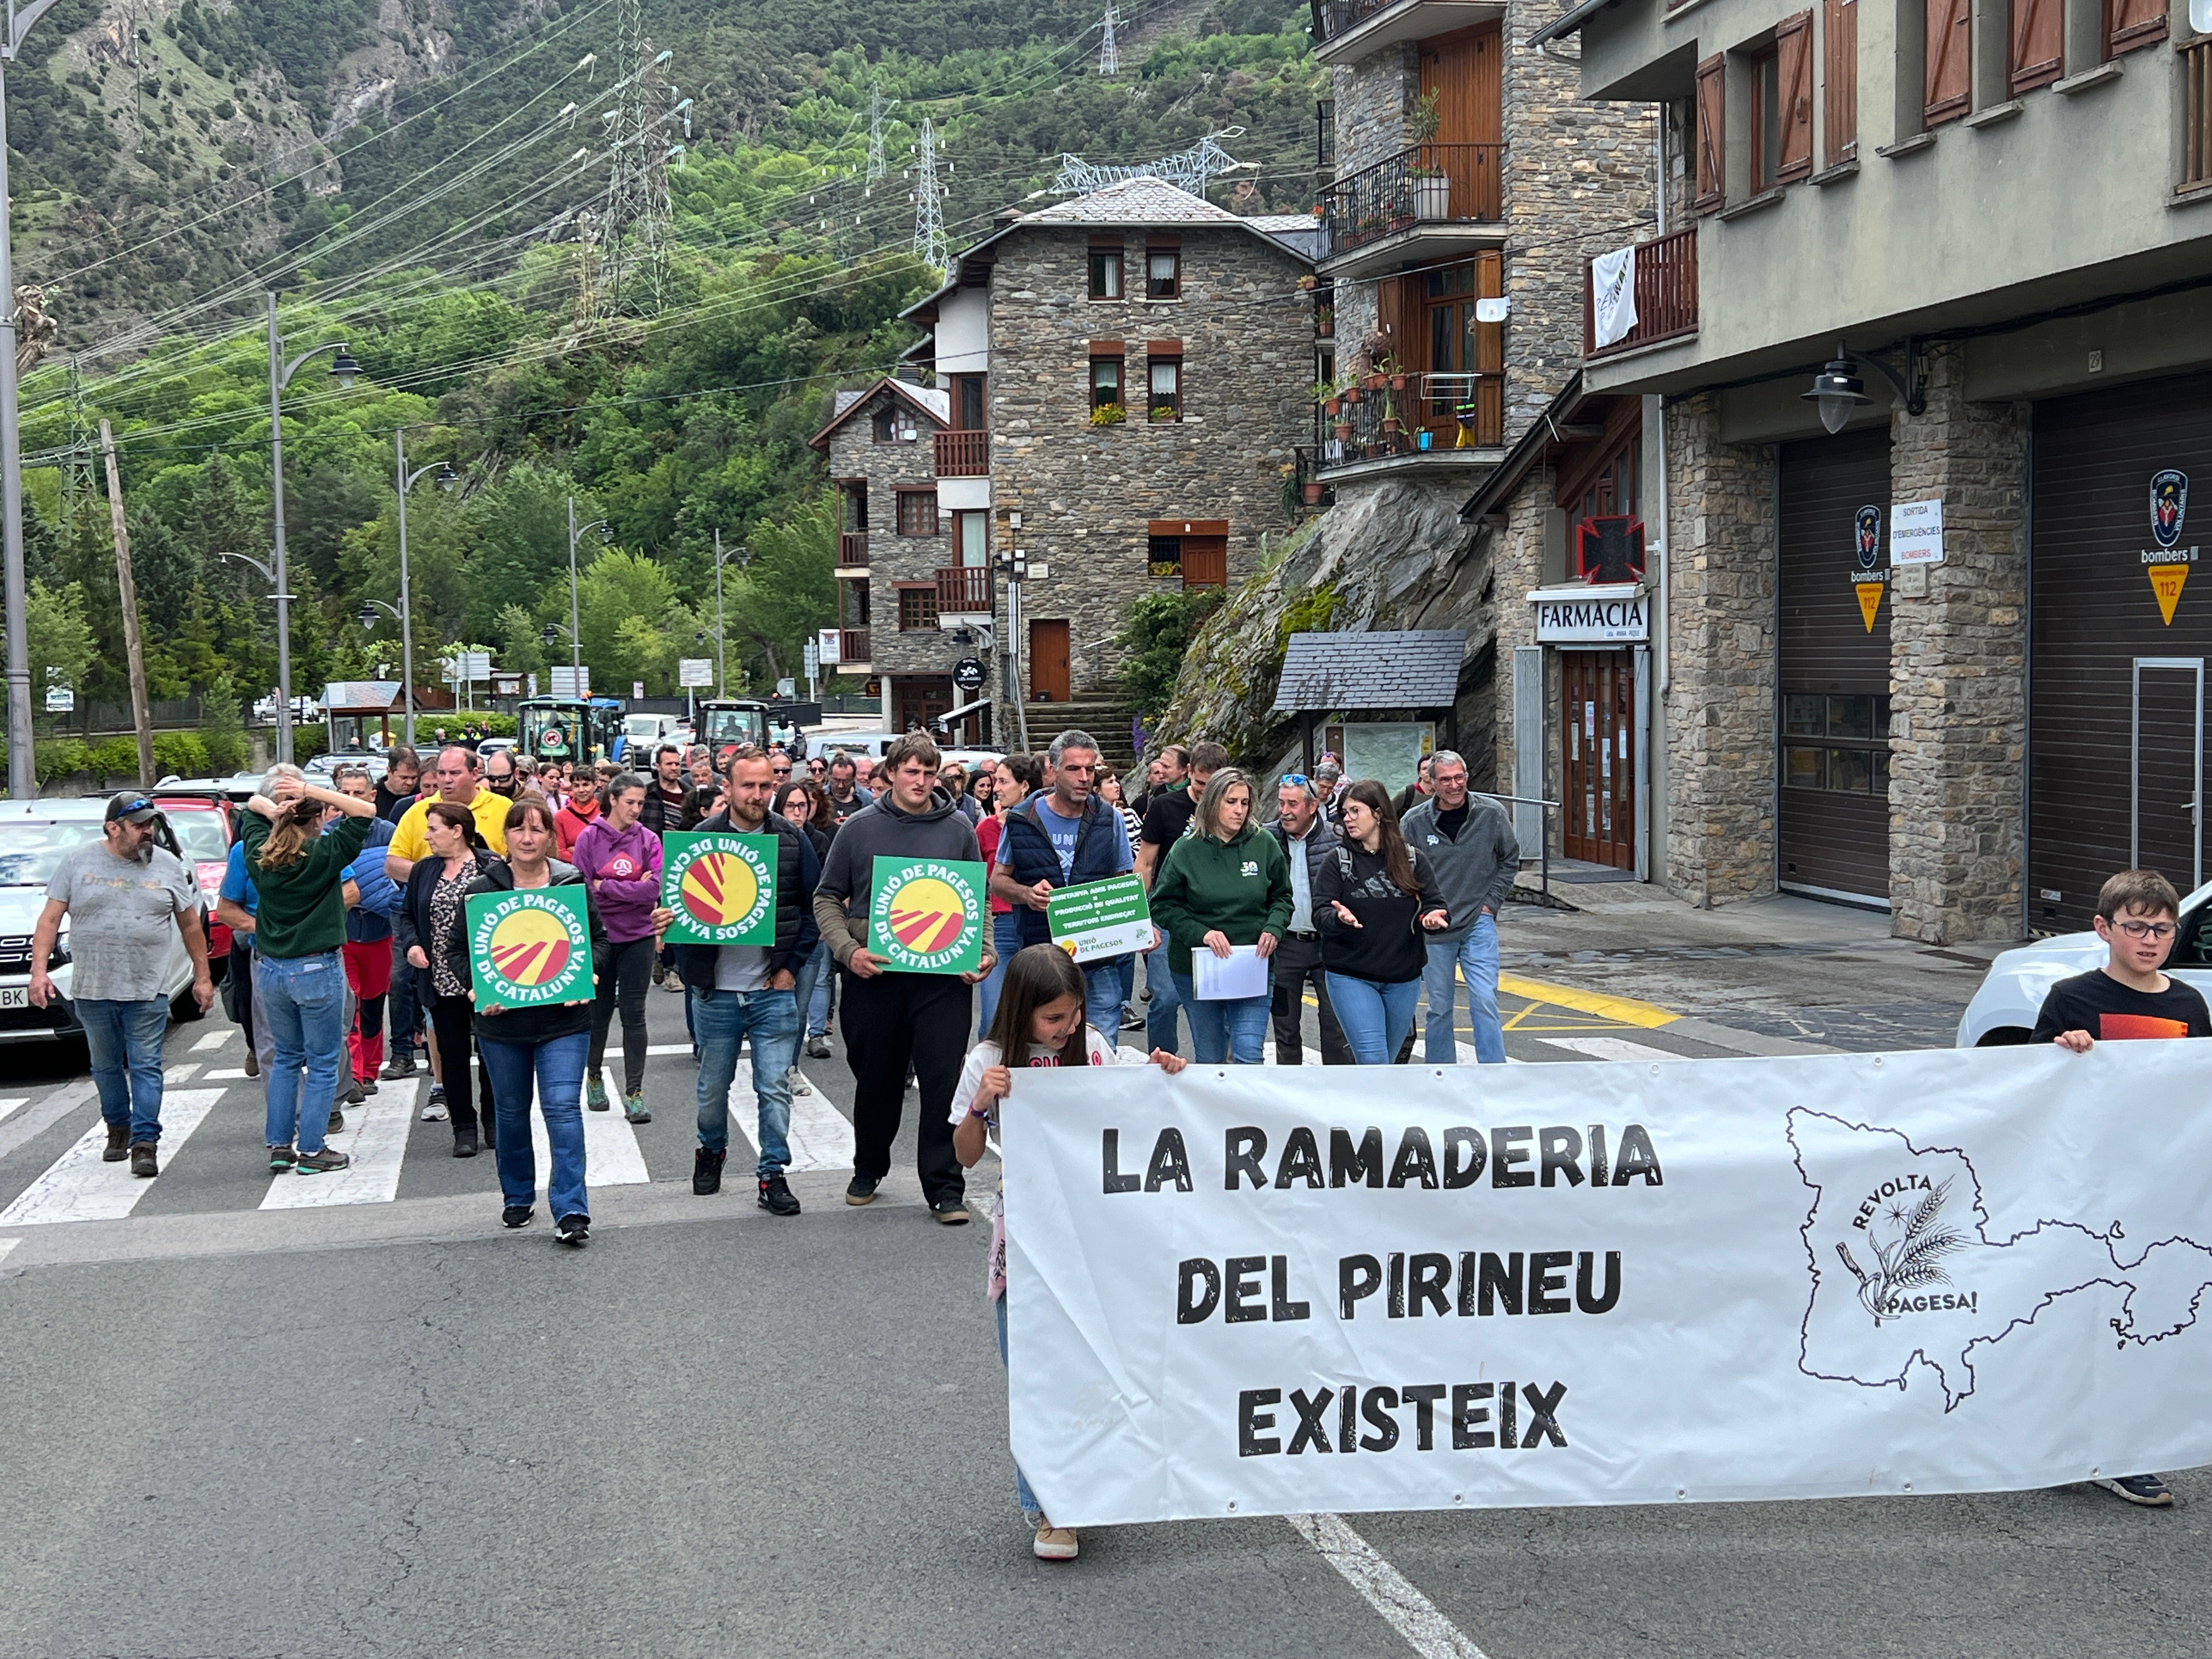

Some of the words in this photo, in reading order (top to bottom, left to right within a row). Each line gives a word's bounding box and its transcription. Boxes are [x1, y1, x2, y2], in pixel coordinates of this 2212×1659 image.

[1903, 506, 1928, 517] SORTIDA
[1893, 526, 1940, 539] D'EMERGÈNCIES
[1901, 549, 1931, 560] BOMBERS
[2141, 549, 2188, 563] bombers
[1851, 570, 1883, 583] bombers
[2159, 581, 2177, 597] 112
[1542, 599, 1643, 627] FARMÀCIA
[1864, 596, 1876, 610] 112
[689, 838, 713, 856] DE
[718, 838, 759, 863] UNIÓ
[753, 862, 771, 885] DE
[666, 853, 710, 940] CATALUNYA
[874, 875, 901, 915] UNIÓ
[901, 864, 925, 881] DE
[928, 864, 979, 921] PAGESOS
[1090, 885, 1106, 894] AMB
[1107, 879, 1139, 891] PAGESOS
[716, 888, 772, 940] PAGESOS
[1054, 902, 1093, 916] PRODUCCIÓ
[1105, 894, 1139, 906] QUALITAT
[475, 912, 498, 955] UNIÓ
[496, 896, 521, 916] DE
[523, 894, 585, 945] PAGESOS
[1063, 917, 1099, 929] TERRITORI
[874, 921, 893, 945] DE
[888, 926, 978, 968] CATALUNYA
[1079, 936, 1097, 946] UNIÓ
[1091, 939, 1123, 951] PAGESOS
[477, 960, 498, 984] DE
[494, 950, 586, 1002] CATALUNYA
[1103, 1127, 1193, 1194] LA
[1224, 1126, 1663, 1190] RAMADERIA
[1852, 1175, 1932, 1230] REVOLTA
[1177, 1255, 1310, 1324] DEL
[1339, 1251, 1621, 1320] PIRINEU
[1887, 1291, 1978, 1314] PAGESA!
[1239, 1381, 1568, 1457] EXISTEIX
